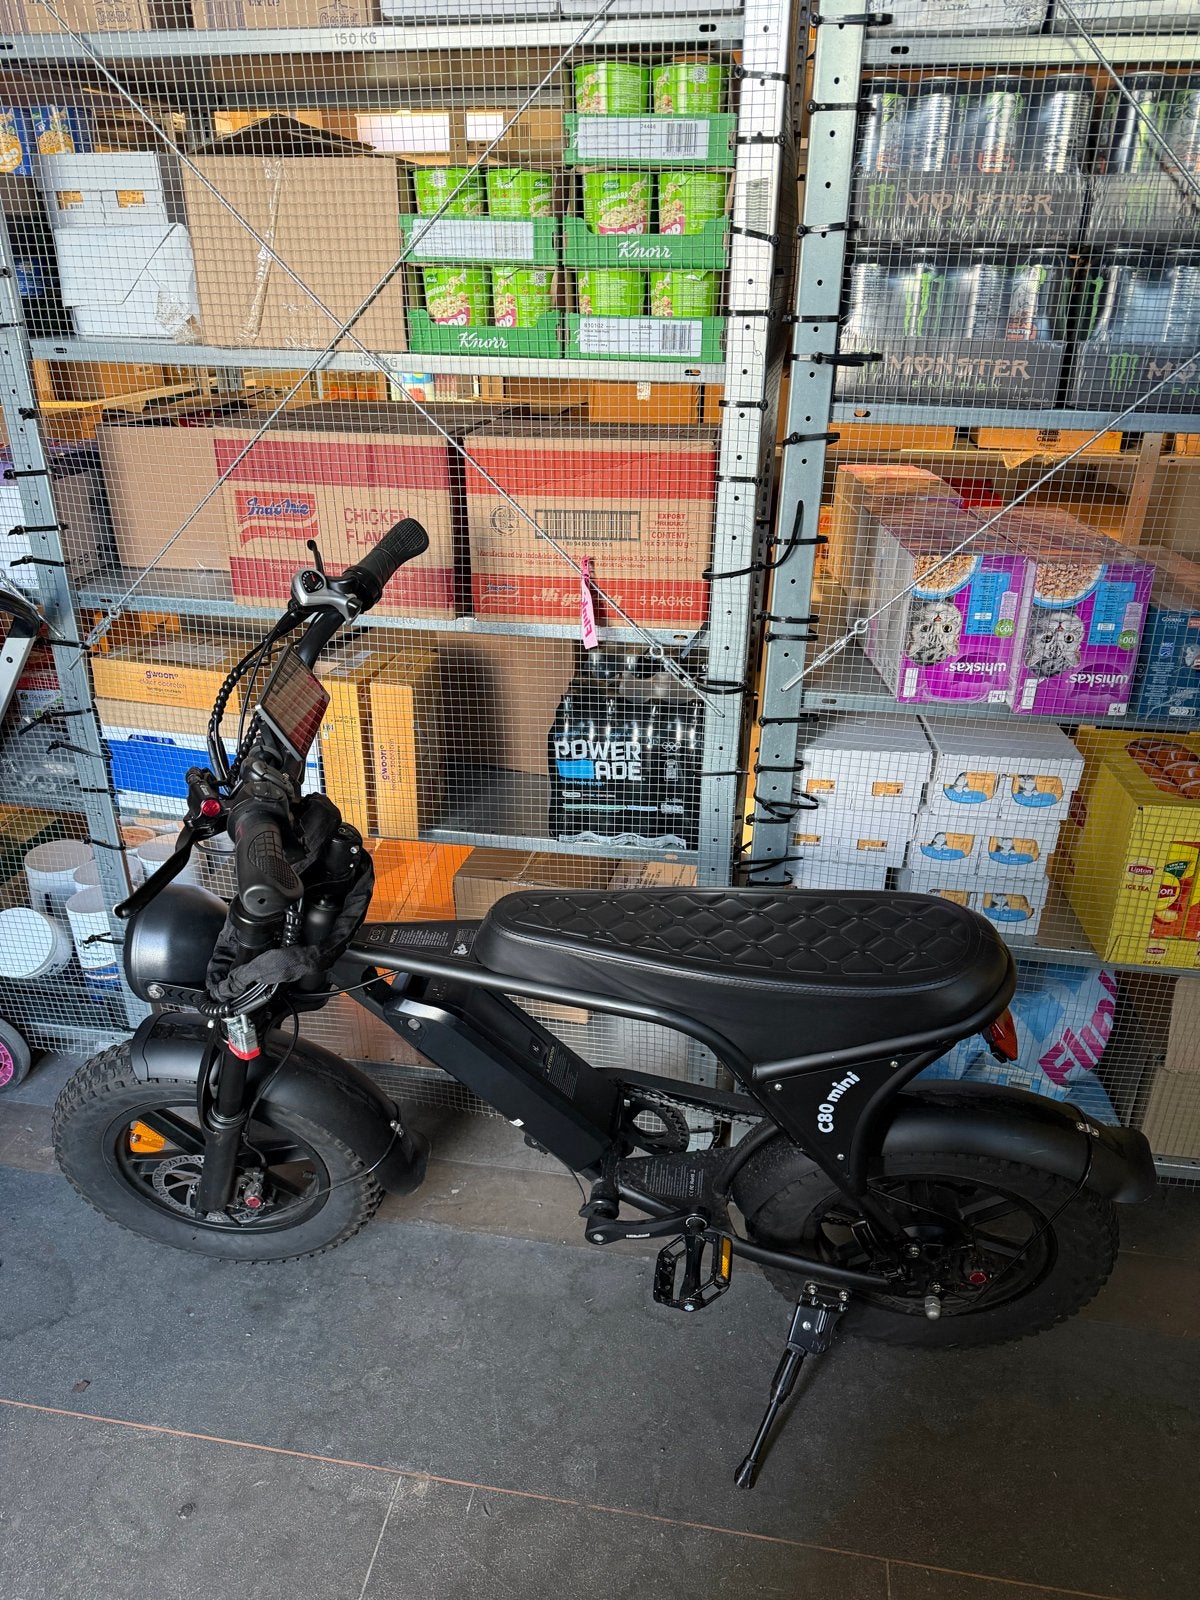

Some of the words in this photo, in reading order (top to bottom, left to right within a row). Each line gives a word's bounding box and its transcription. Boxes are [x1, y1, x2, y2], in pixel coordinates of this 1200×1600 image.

[335, 33, 356, 45] 150
[360, 32, 377, 44] KG
[905, 191, 1053, 216] MONSTER
[617, 240, 672, 258] Knorr
[458, 331, 509, 349] Knorr
[889, 353, 1031, 380] MONSTER
[650, 596, 694, 607] PACKS
[948, 662, 1007, 675] whiskas
[1068, 673, 1129, 688] whiskas
[553, 740, 641, 760] POWER
[1130, 866, 1152, 874] Lipton
[817, 1103, 835, 1133] C80
[826, 1071, 861, 1103] mini
